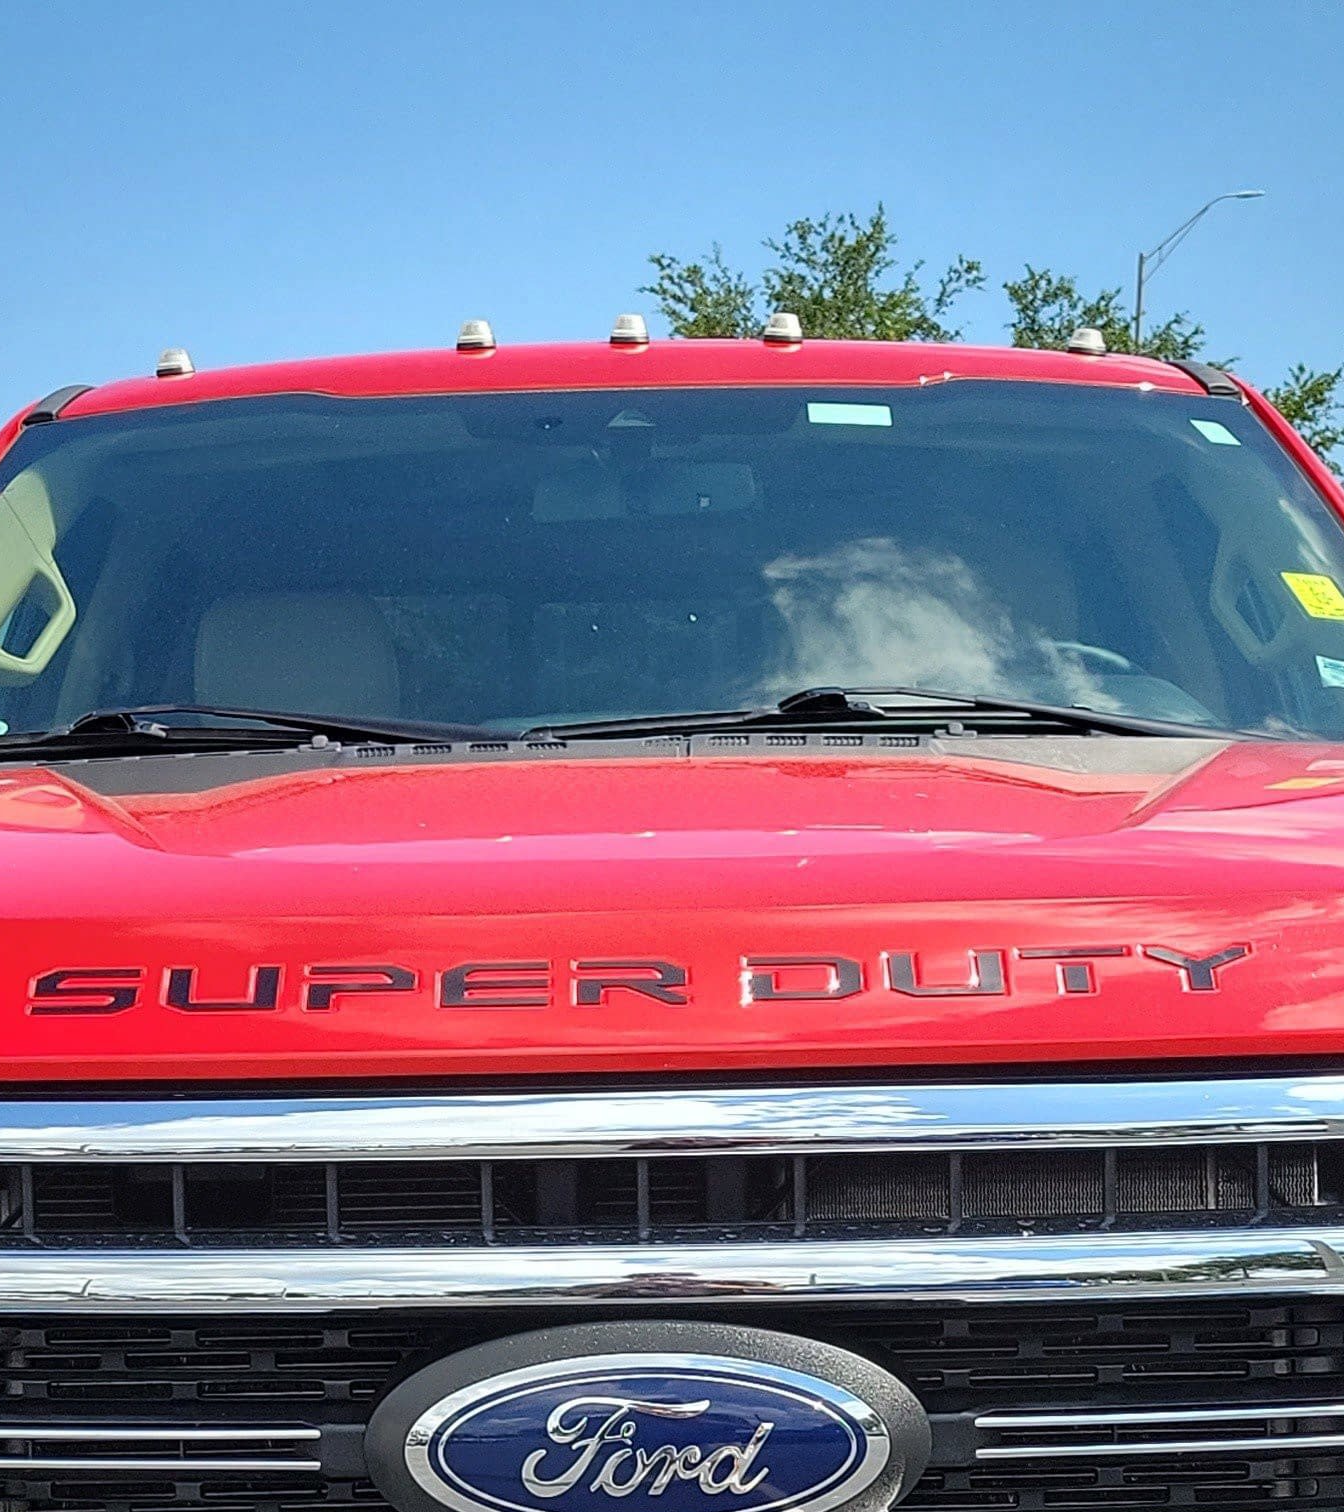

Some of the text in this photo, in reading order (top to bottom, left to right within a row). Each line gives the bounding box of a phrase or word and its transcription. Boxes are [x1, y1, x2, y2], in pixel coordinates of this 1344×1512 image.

[26, 943, 1250, 1016] SUPER DUTY
[521, 1396, 774, 1498] Ford
